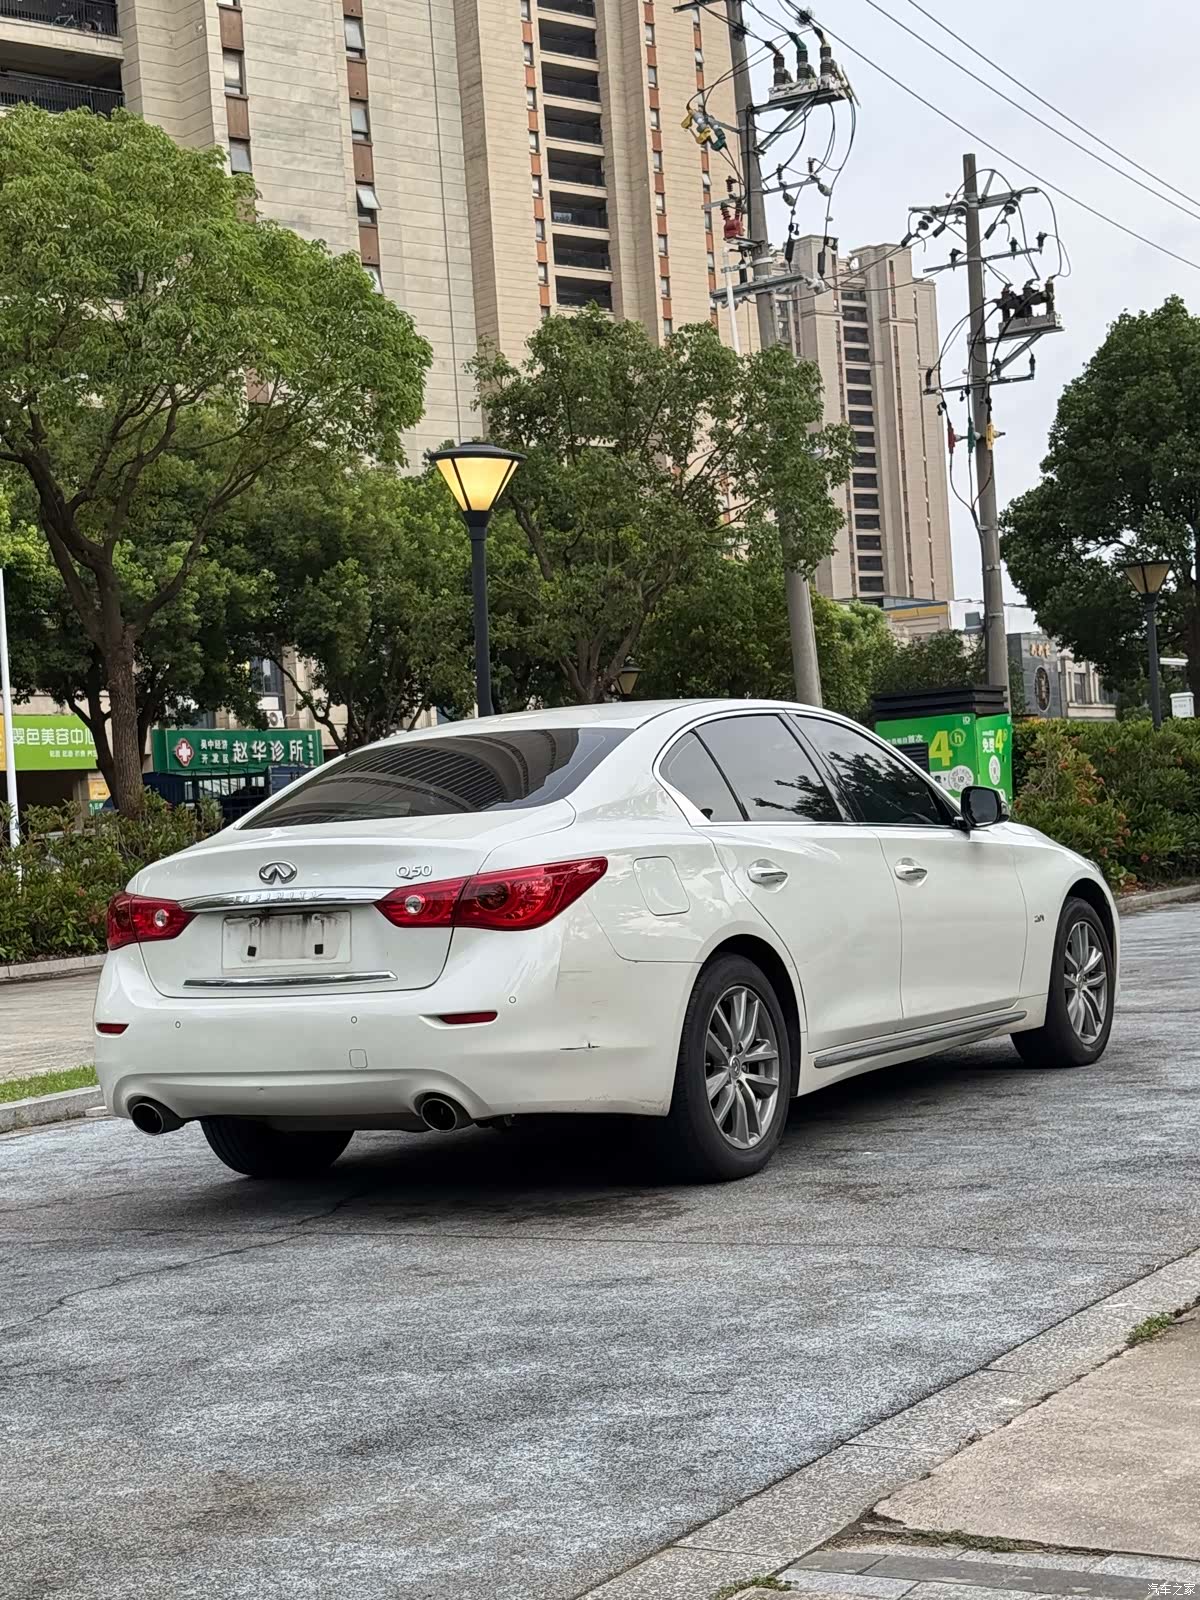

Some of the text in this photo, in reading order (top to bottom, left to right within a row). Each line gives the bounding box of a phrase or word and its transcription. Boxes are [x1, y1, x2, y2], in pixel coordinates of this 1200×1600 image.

[201, 753, 229, 764] 开发区
[232, 740, 304, 763] 赵华诊所
[929, 731, 953, 767] 4
[396, 865, 432, 880] Q50
